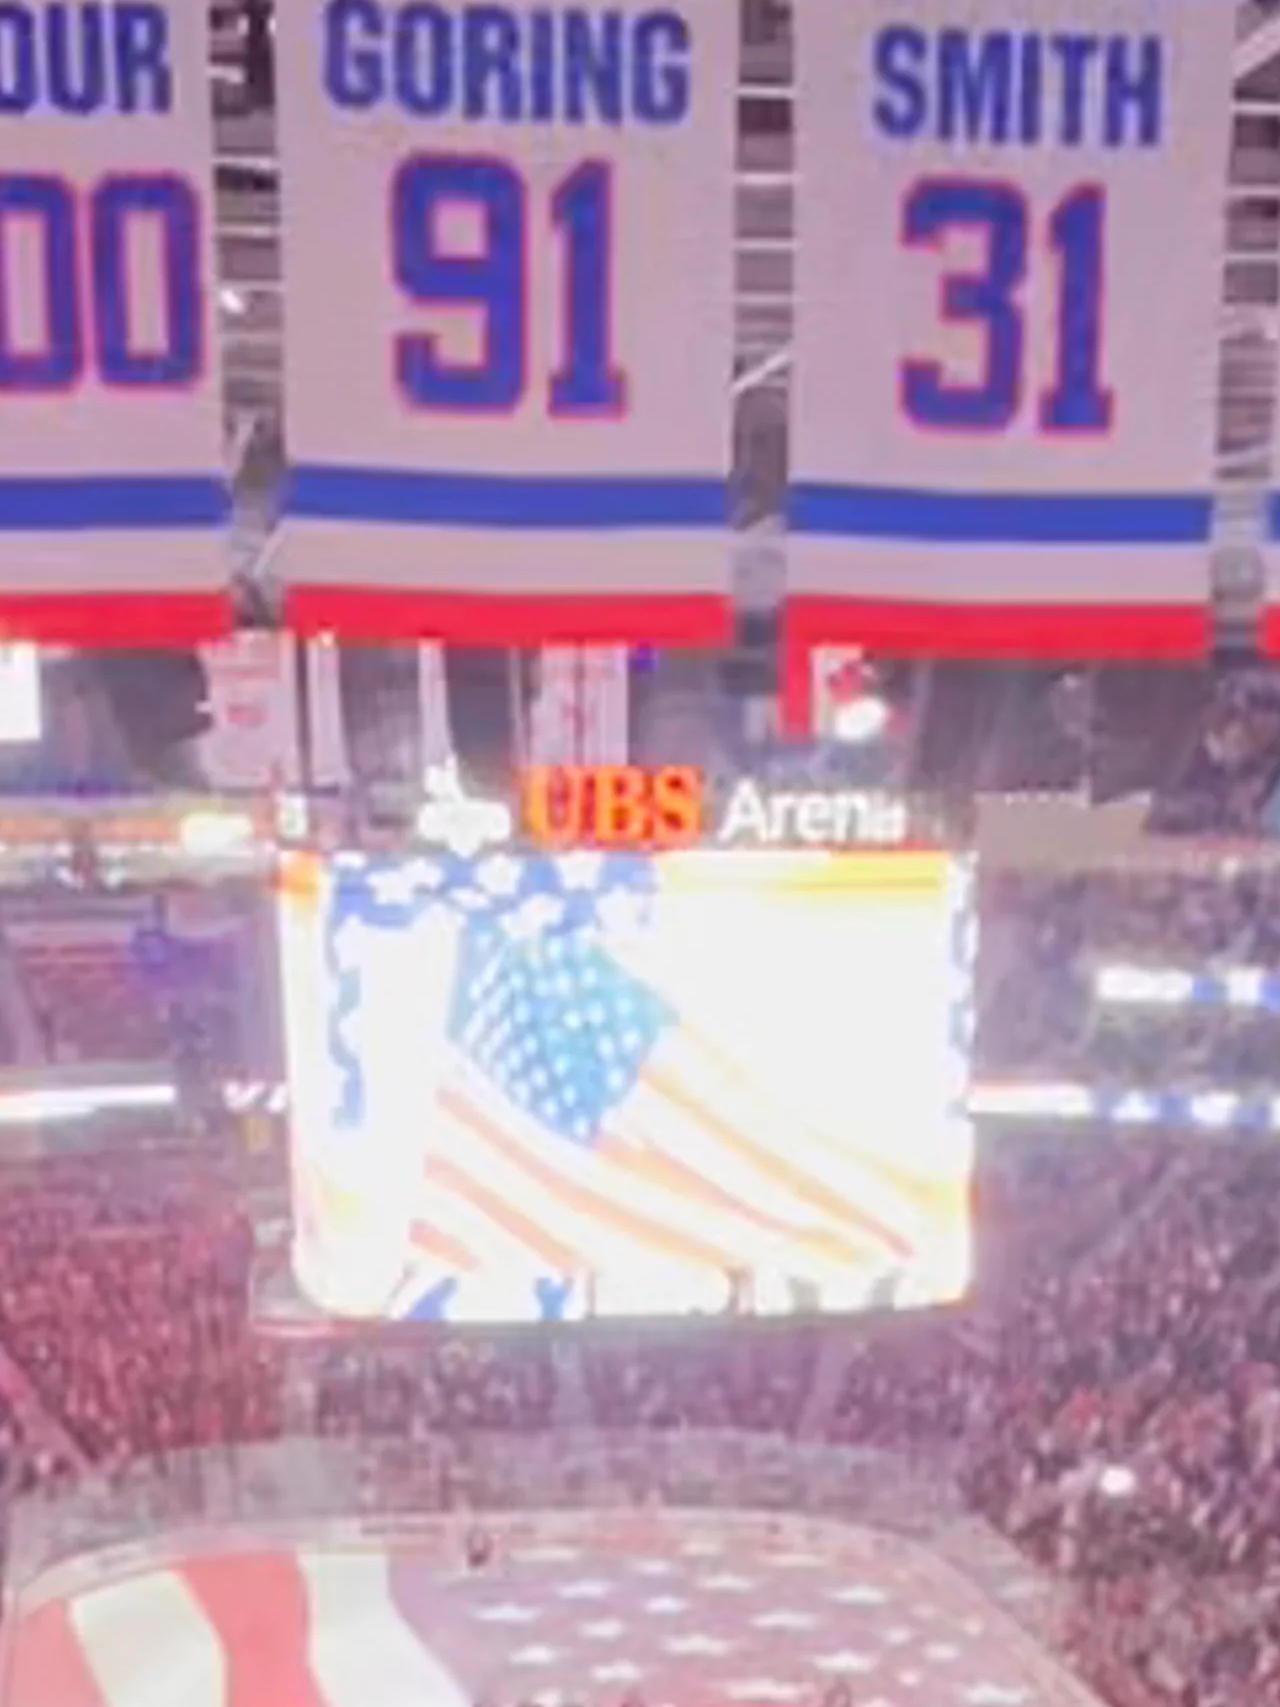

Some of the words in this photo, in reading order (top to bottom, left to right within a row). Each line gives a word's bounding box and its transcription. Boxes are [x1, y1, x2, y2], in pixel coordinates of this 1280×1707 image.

[871, 24, 1163, 148] SMITH
[389, 150, 629, 419] 91
[898, 174, 1115, 437] 31
[526, 765, 700, 849] UBS
[718, 778, 906, 843] Arena
